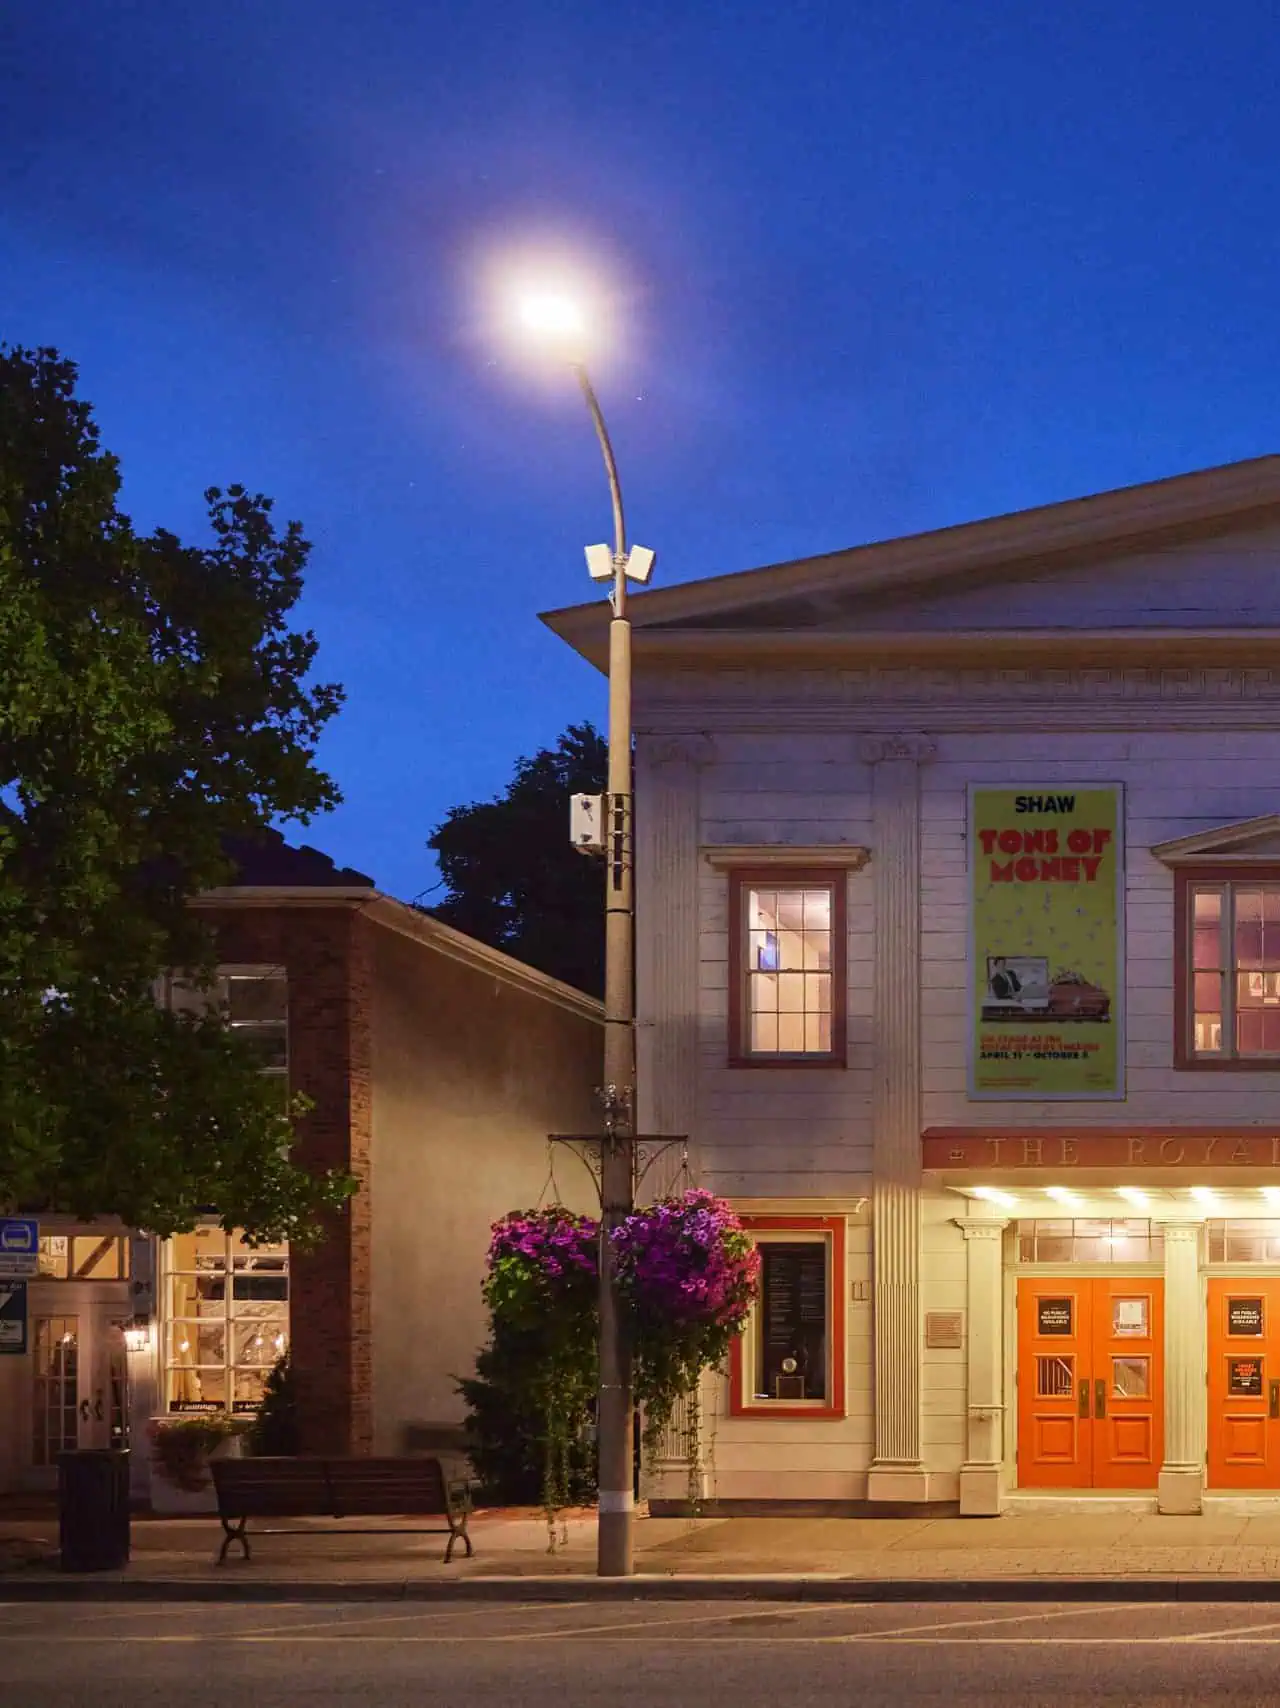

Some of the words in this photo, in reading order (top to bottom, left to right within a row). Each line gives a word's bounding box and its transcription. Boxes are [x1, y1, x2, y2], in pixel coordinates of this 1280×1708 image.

[1014, 795, 1075, 813] SHAW
[978, 828, 1058, 854] TONS
[1067, 828, 1112, 854] OF
[990, 856, 1103, 882] MONEY
[985, 1137, 1080, 1166] THE
